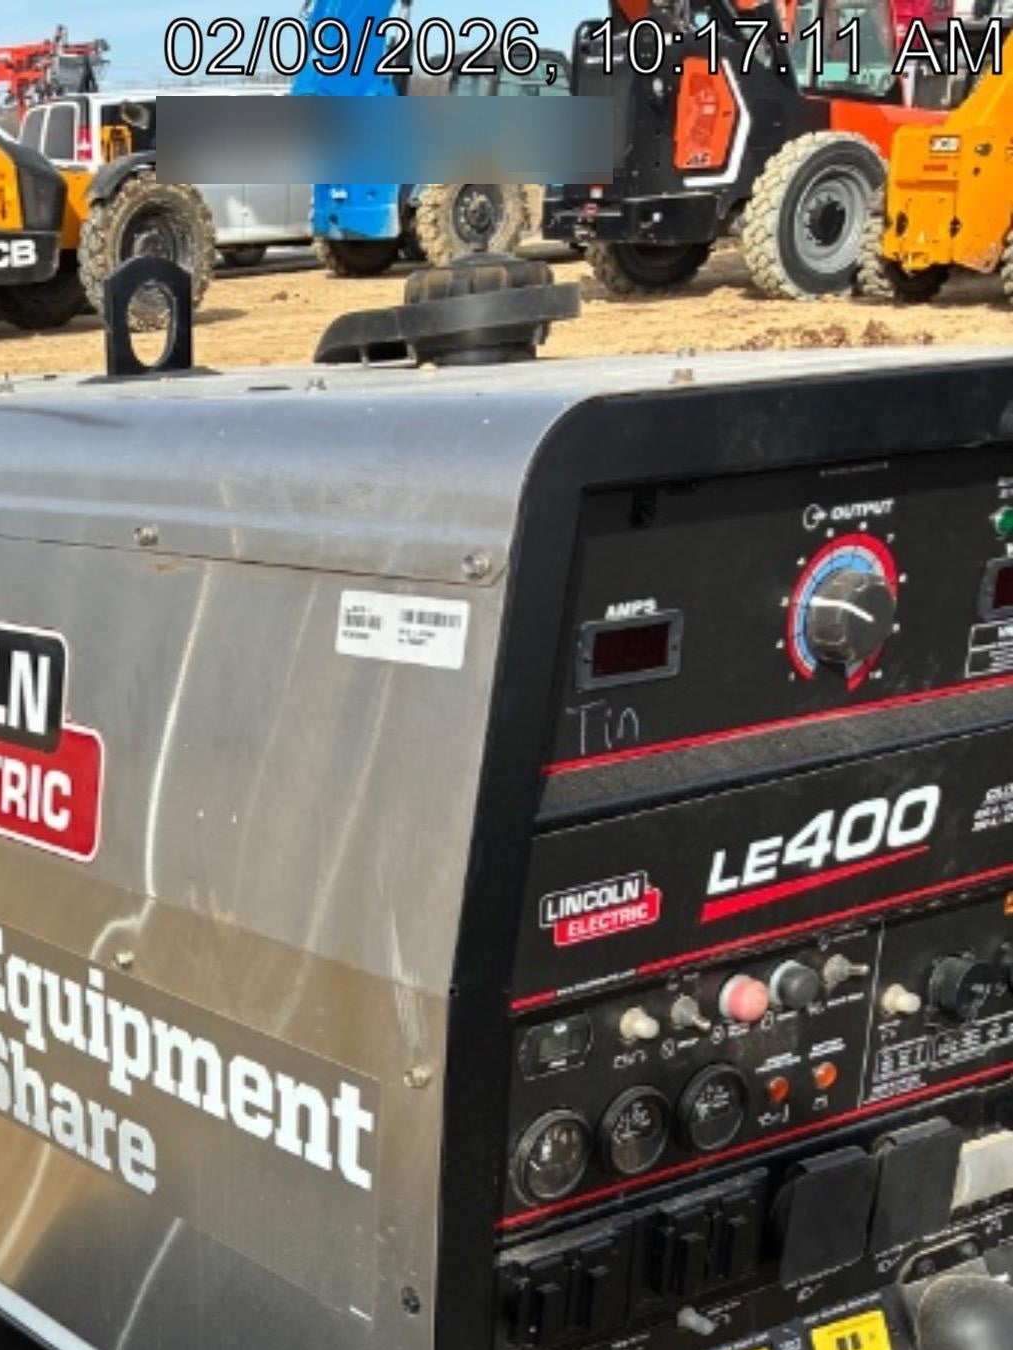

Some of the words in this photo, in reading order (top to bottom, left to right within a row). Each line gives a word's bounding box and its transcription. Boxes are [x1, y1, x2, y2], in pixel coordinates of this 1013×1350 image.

[831, 498, 894, 521] OUTPUT
[605, 598, 658, 621] AMPS
[706, 785, 941, 895] LE400
[545, 878, 641, 921] LINCOLN
[568, 902, 649, 937] ELECTRIC
